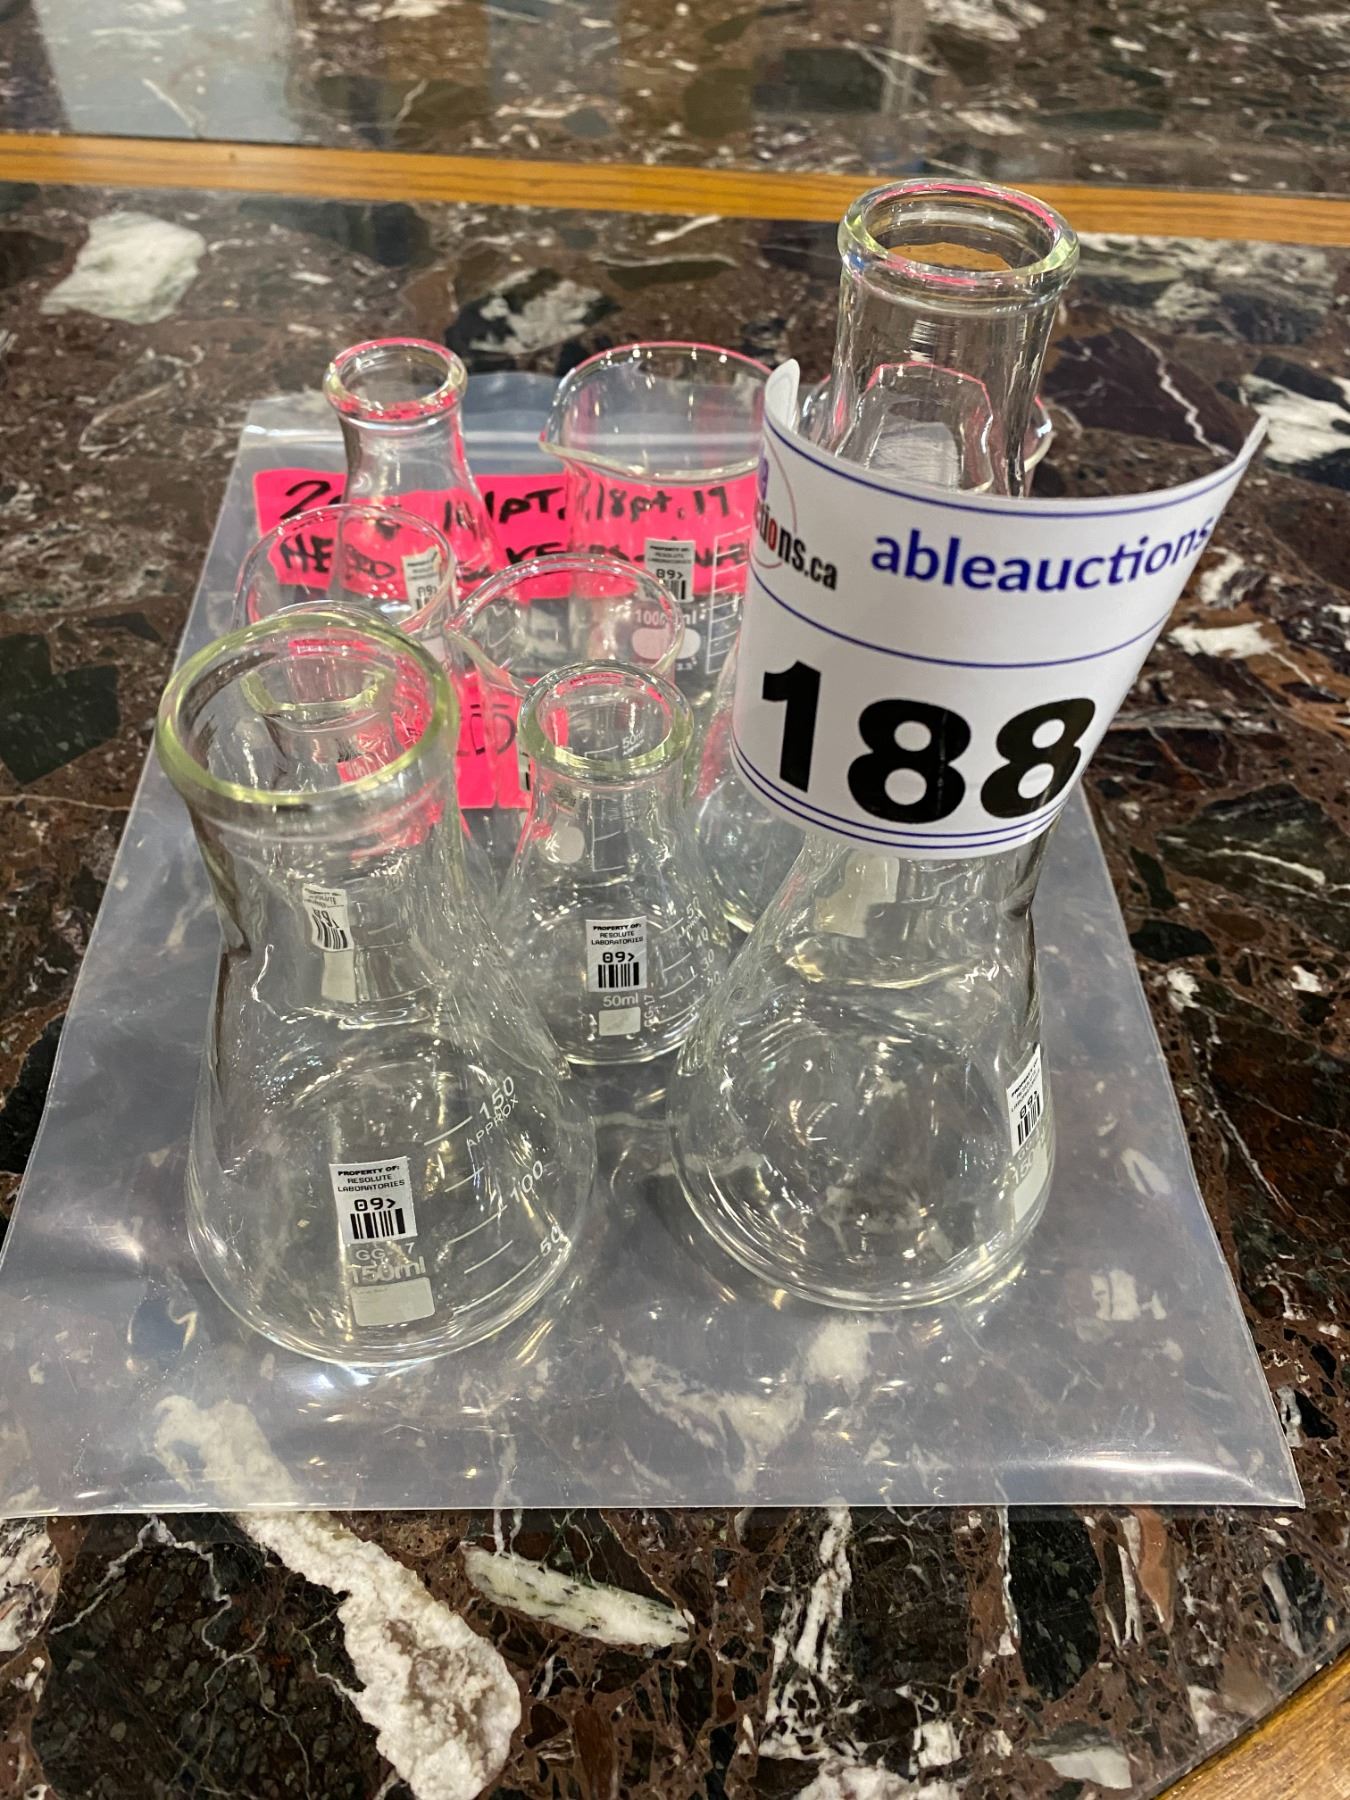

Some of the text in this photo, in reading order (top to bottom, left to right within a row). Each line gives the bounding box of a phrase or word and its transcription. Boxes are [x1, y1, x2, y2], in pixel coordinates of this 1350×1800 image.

[755, 499, 838, 591] tions.ca
[870, 516, 1214, 593] ableauctions
[762, 660, 1096, 825] 188
[591, 936, 644, 946] LABORATORIES
[592, 924, 629, 932] PROPERTY
[599, 930, 635, 939] RESOLUTE
[602, 991, 639, 1008] 50ml
[480, 1076, 514, 1119] 150
[466, 1094, 519, 1151] APPROX
[337, 1179, 406, 1193] LABORATORIES
[338, 1167, 383, 1177] PROPERTY
[347, 1174, 393, 1185] RESOLUTE
[510, 1160, 543, 1204] 100
[540, 1225, 563, 1256] 50
[350, 1255, 427, 1285] 150ml
